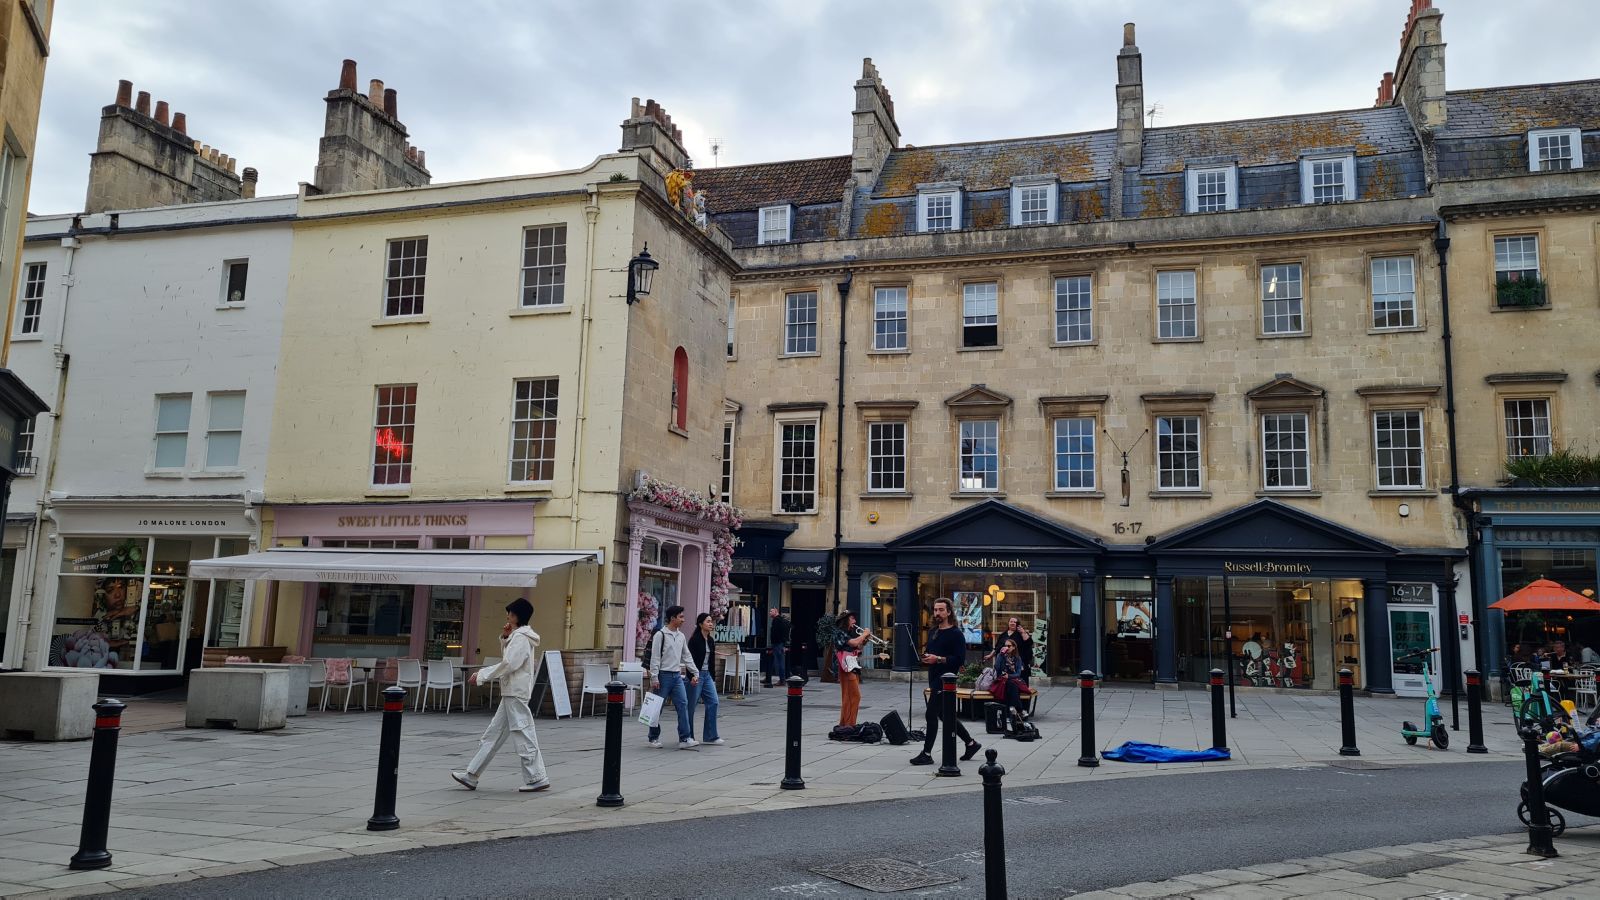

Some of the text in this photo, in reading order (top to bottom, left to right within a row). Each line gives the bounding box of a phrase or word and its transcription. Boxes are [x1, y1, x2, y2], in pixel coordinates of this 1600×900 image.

[1496, 501, 1517, 511] THE
[1520, 501, 1552, 512] BATH
[338, 514, 468, 528] SWEET LITTLE THINGS
[315, 572, 399, 582] SWEET LITTLE THINGS
